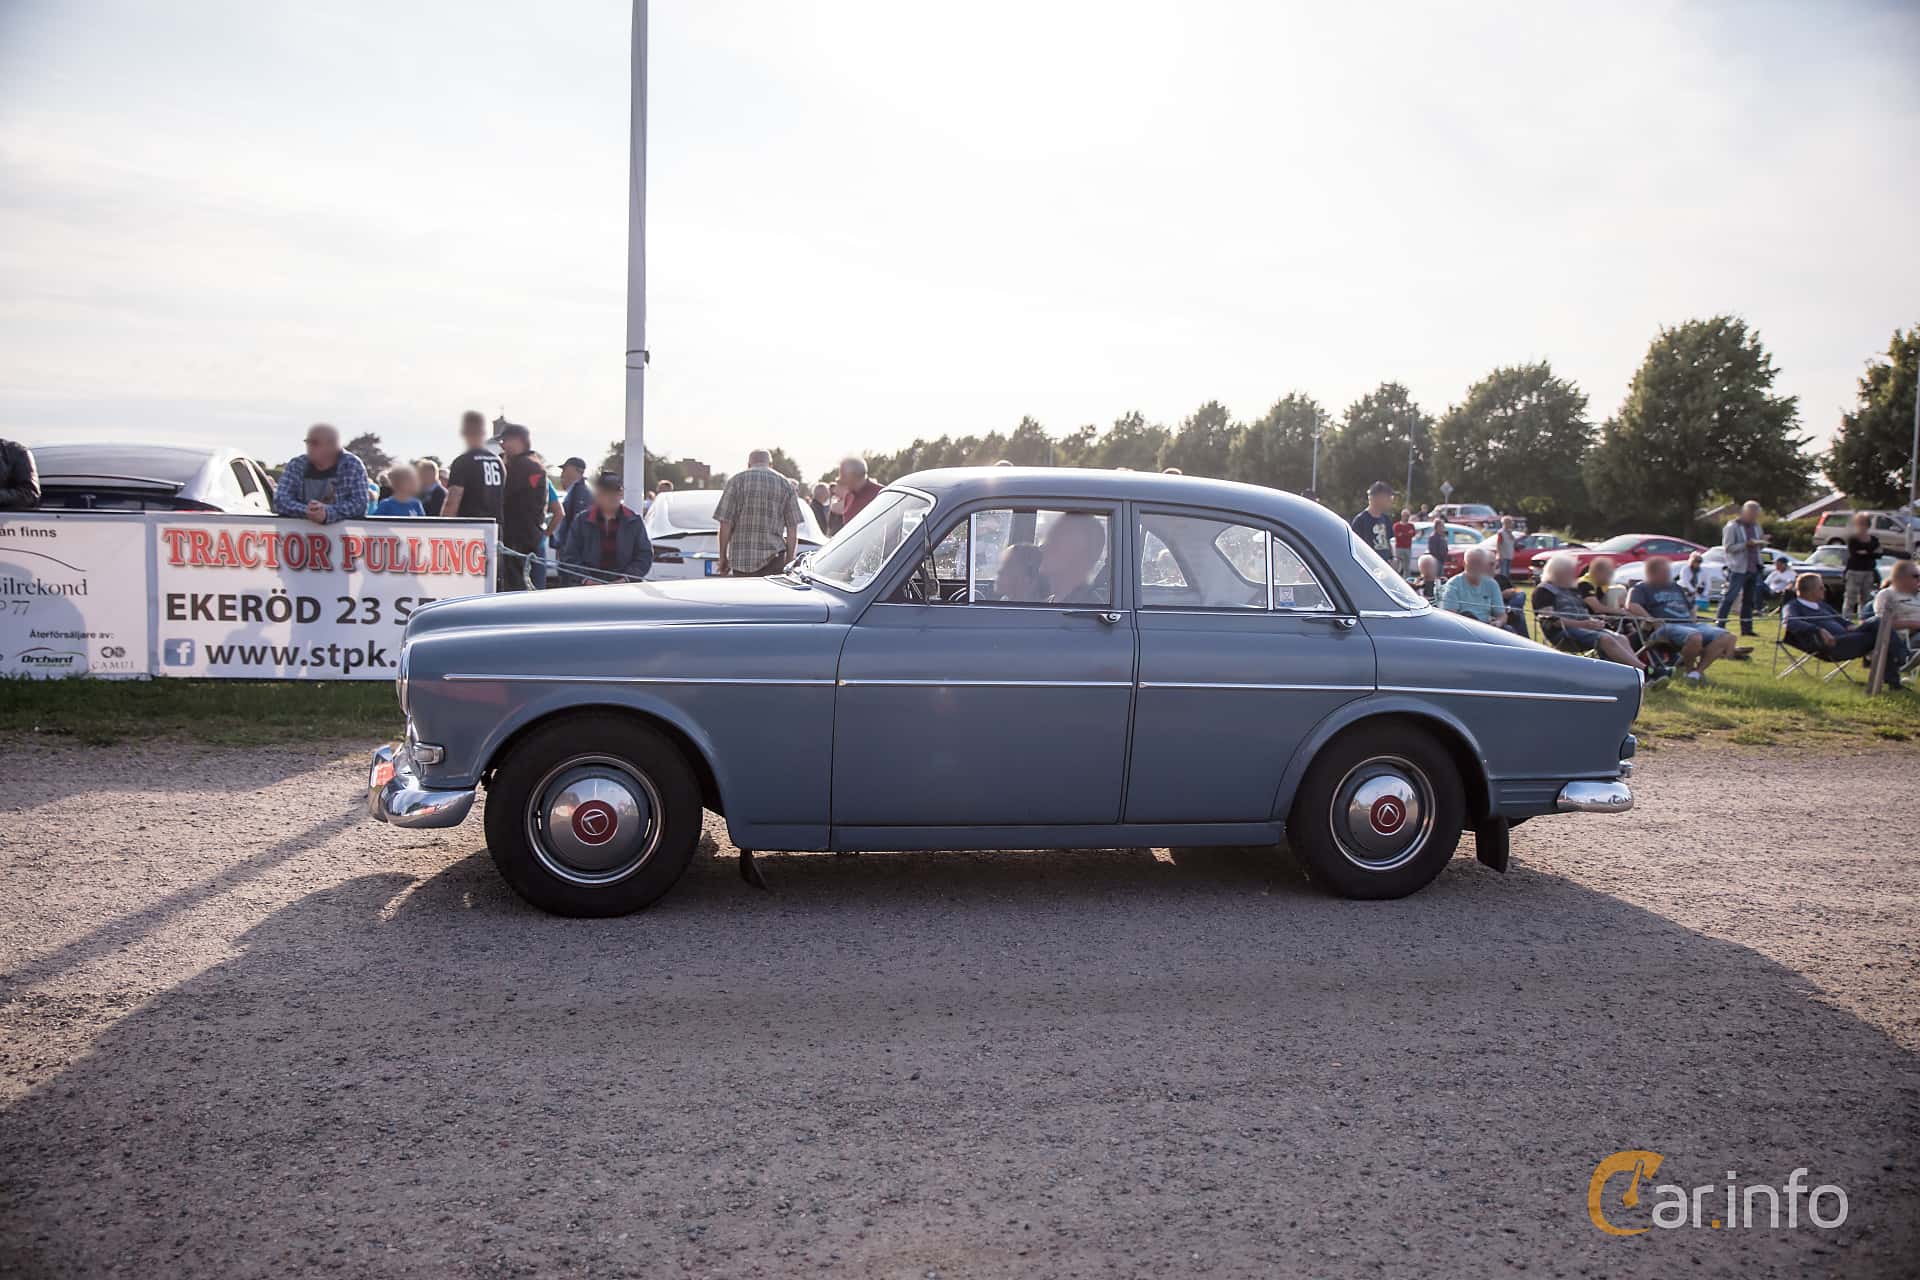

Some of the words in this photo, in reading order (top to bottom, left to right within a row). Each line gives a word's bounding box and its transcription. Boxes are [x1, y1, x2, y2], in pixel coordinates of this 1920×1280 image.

[483, 461, 501, 486] 86
[21, 526, 57, 538] finns
[163, 528, 333, 571] TRACTOR
[341, 534, 488, 575] PULLING
[0, 577, 88, 596] ilrekond
[166, 588, 321, 624] EKERÖD
[336, 596, 381, 625] 23
[21, 655, 74, 664] Orchard
[205, 640, 397, 674] www.stpk.
